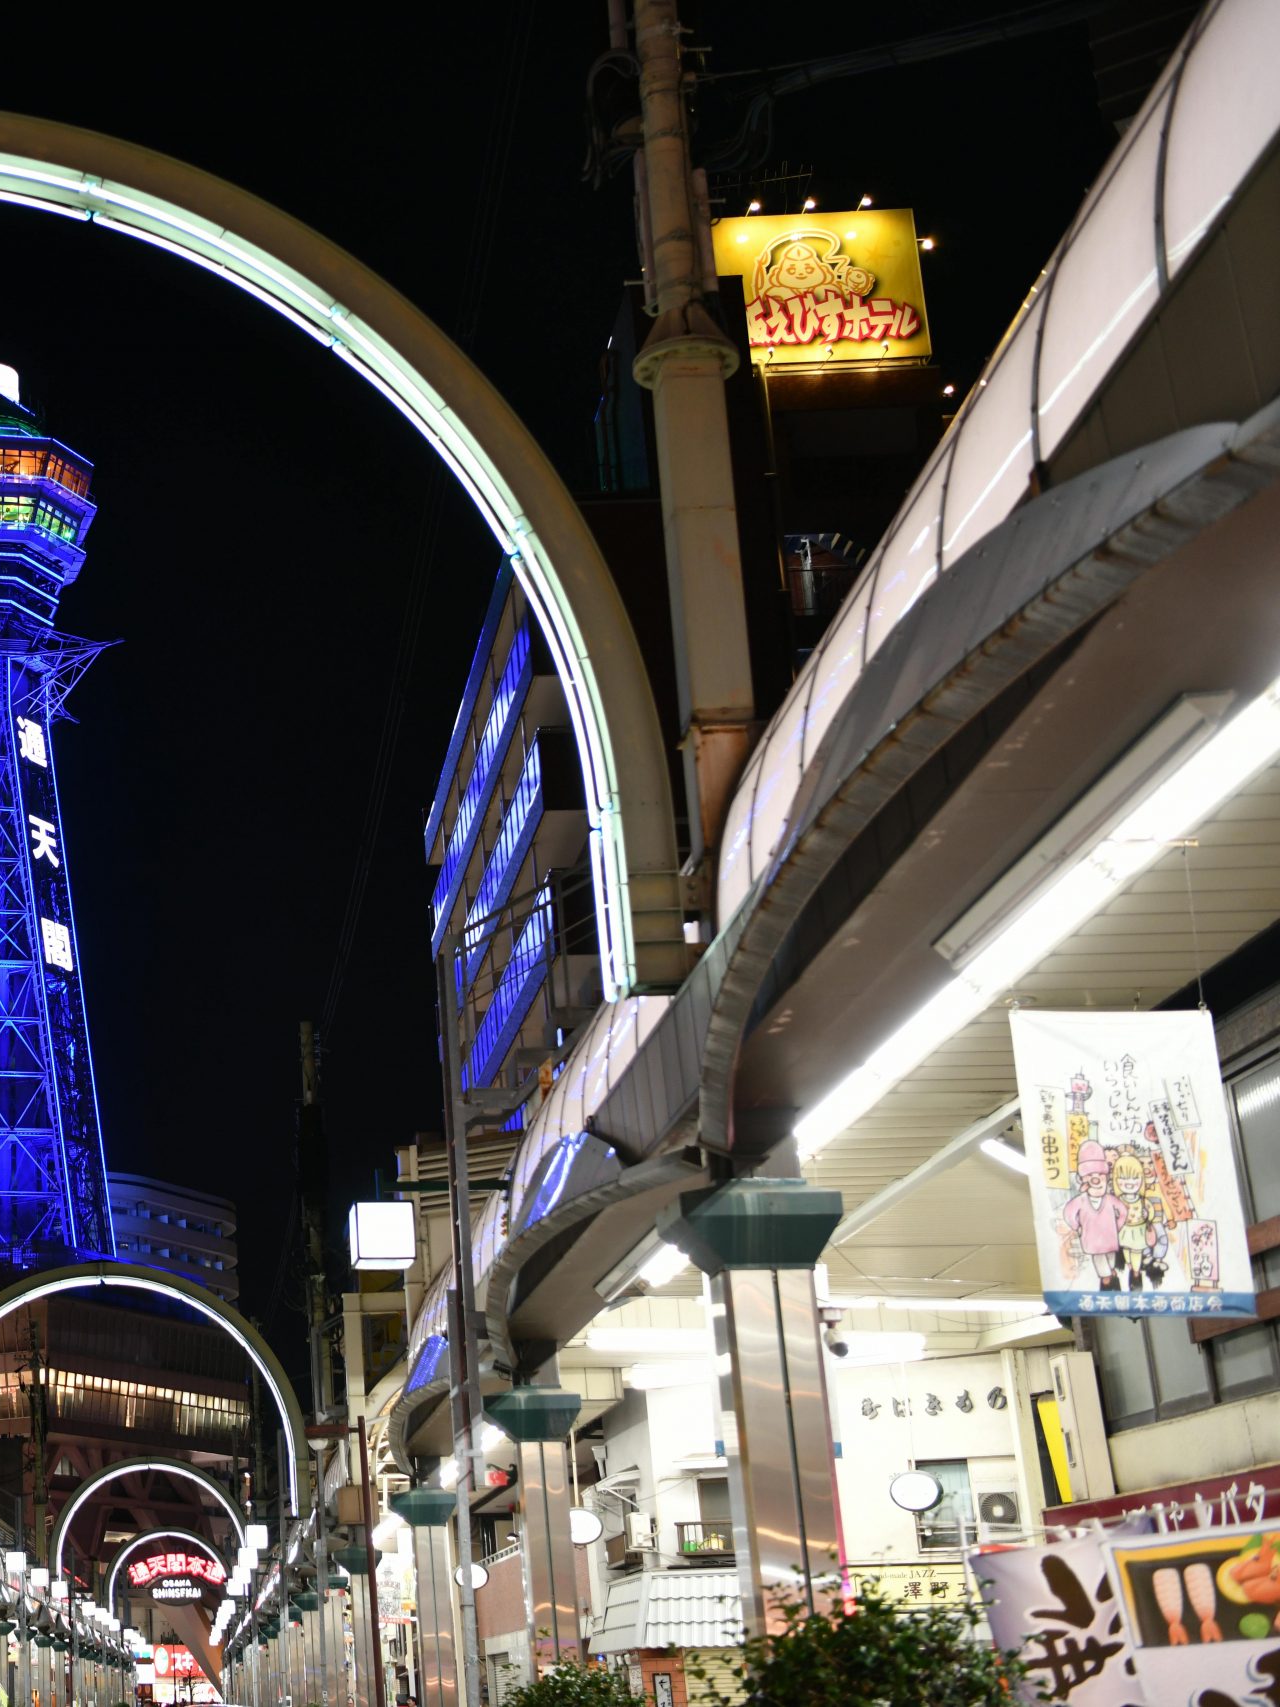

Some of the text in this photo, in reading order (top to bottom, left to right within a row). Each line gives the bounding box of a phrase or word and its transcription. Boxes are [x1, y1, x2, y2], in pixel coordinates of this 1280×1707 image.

[17, 715, 74, 973] 通天閣
[129, 1553, 227, 1586] 通天閣本通
[909, 1569, 937, 1579] JAZZ
[162, 1579, 192, 1588] OSAKA
[152, 1587, 202, 1599] SHINSEKAI
